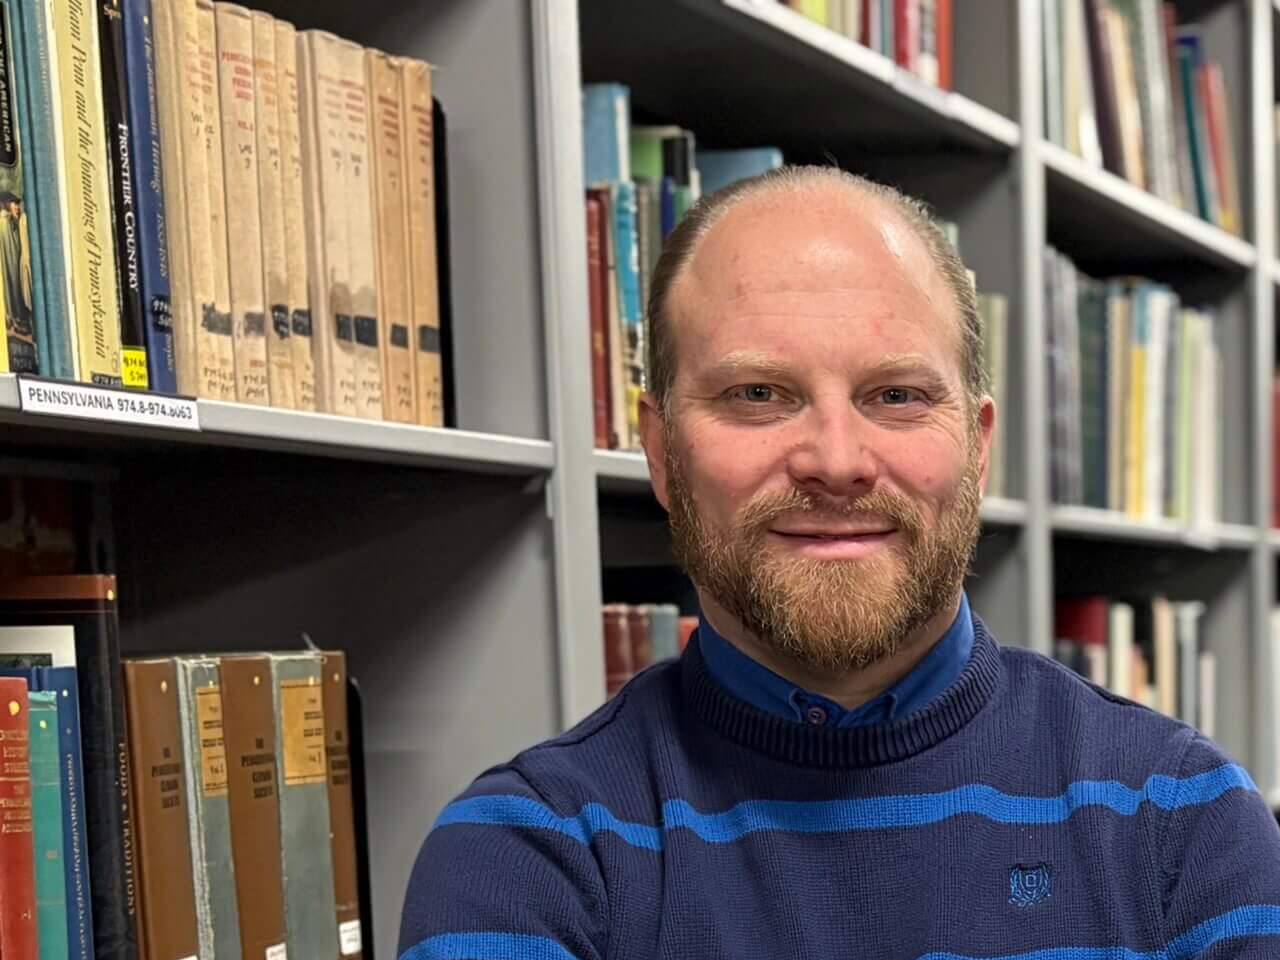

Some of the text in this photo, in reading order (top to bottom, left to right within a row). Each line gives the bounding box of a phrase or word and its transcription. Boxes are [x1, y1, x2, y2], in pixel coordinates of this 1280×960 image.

[72, 44, 87, 87] Penn
[75, 90, 92, 128] and
[78, 126, 94, 155] the
[78, 154, 99, 227] founding
[118, 122, 139, 292] FRONTIER COUNTRY
[87, 231, 102, 252] of
[88, 248, 109, 359] Pennsylvania
[28, 387, 114, 411] PENNSYLVANIA
[118, 742, 129, 797] FOODS
[120, 818, 136, 916] TRADITIONS
